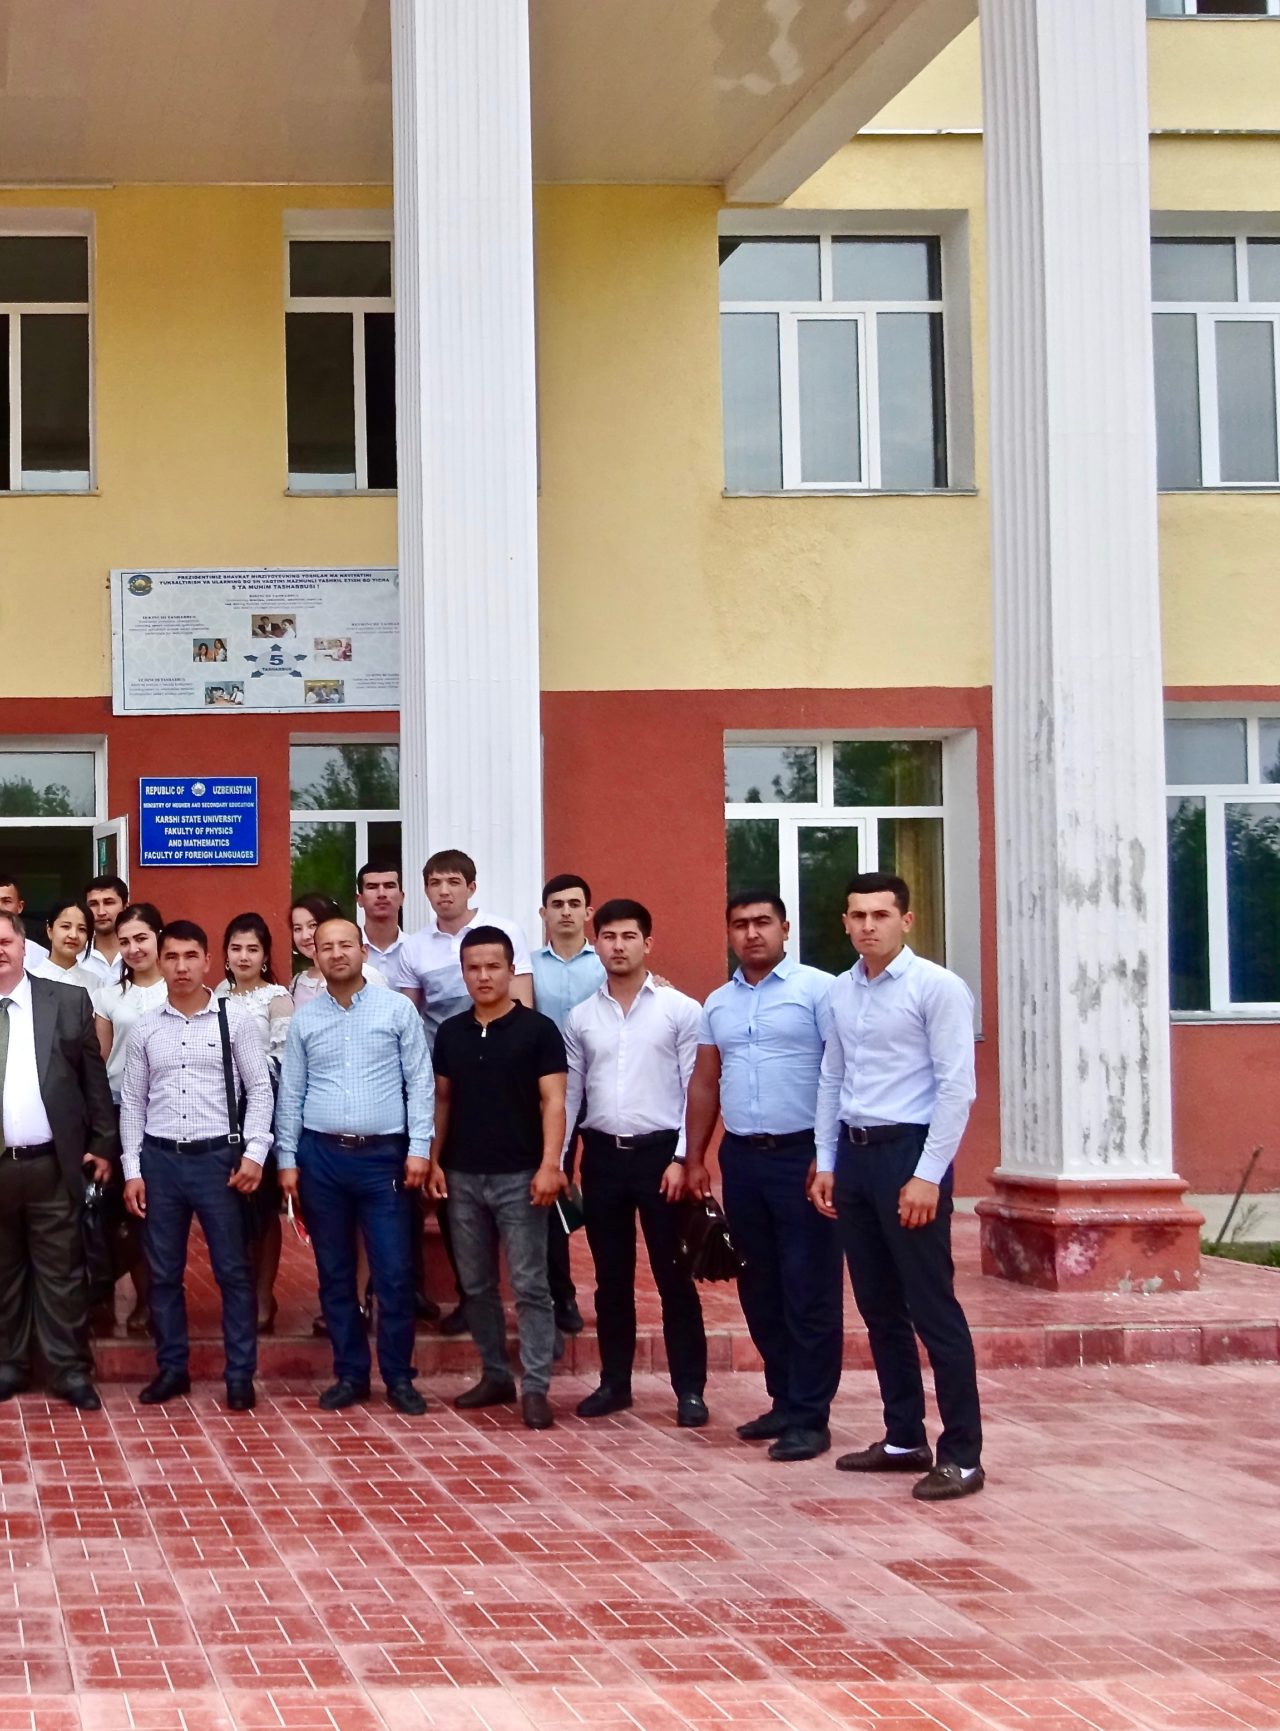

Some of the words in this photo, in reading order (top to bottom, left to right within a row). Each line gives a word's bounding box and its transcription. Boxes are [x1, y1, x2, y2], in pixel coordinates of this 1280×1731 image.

[269, 654, 284, 666] 5
[145, 786, 175, 795] REPUBLIC
[176, 786, 185, 795] OF
[212, 785, 252, 795] UZBEKISTAN
[155, 815, 180, 823] KARSHI
[181, 815, 202, 823] STATE
[203, 815, 242, 823] UNIVERSITY
[164, 827, 193, 835] FAKULTY
[195, 827, 203, 835] OF
[205, 827, 234, 835] PHYSICS
[168, 839, 182, 847] AND
[183, 839, 230, 847] MATHEMATICS
[144, 851, 173, 859] FACULTY
[174, 851, 183, 859] OF
[184, 851, 214, 859] FOREIGN
[214, 851, 254, 859] LANGUAGES
